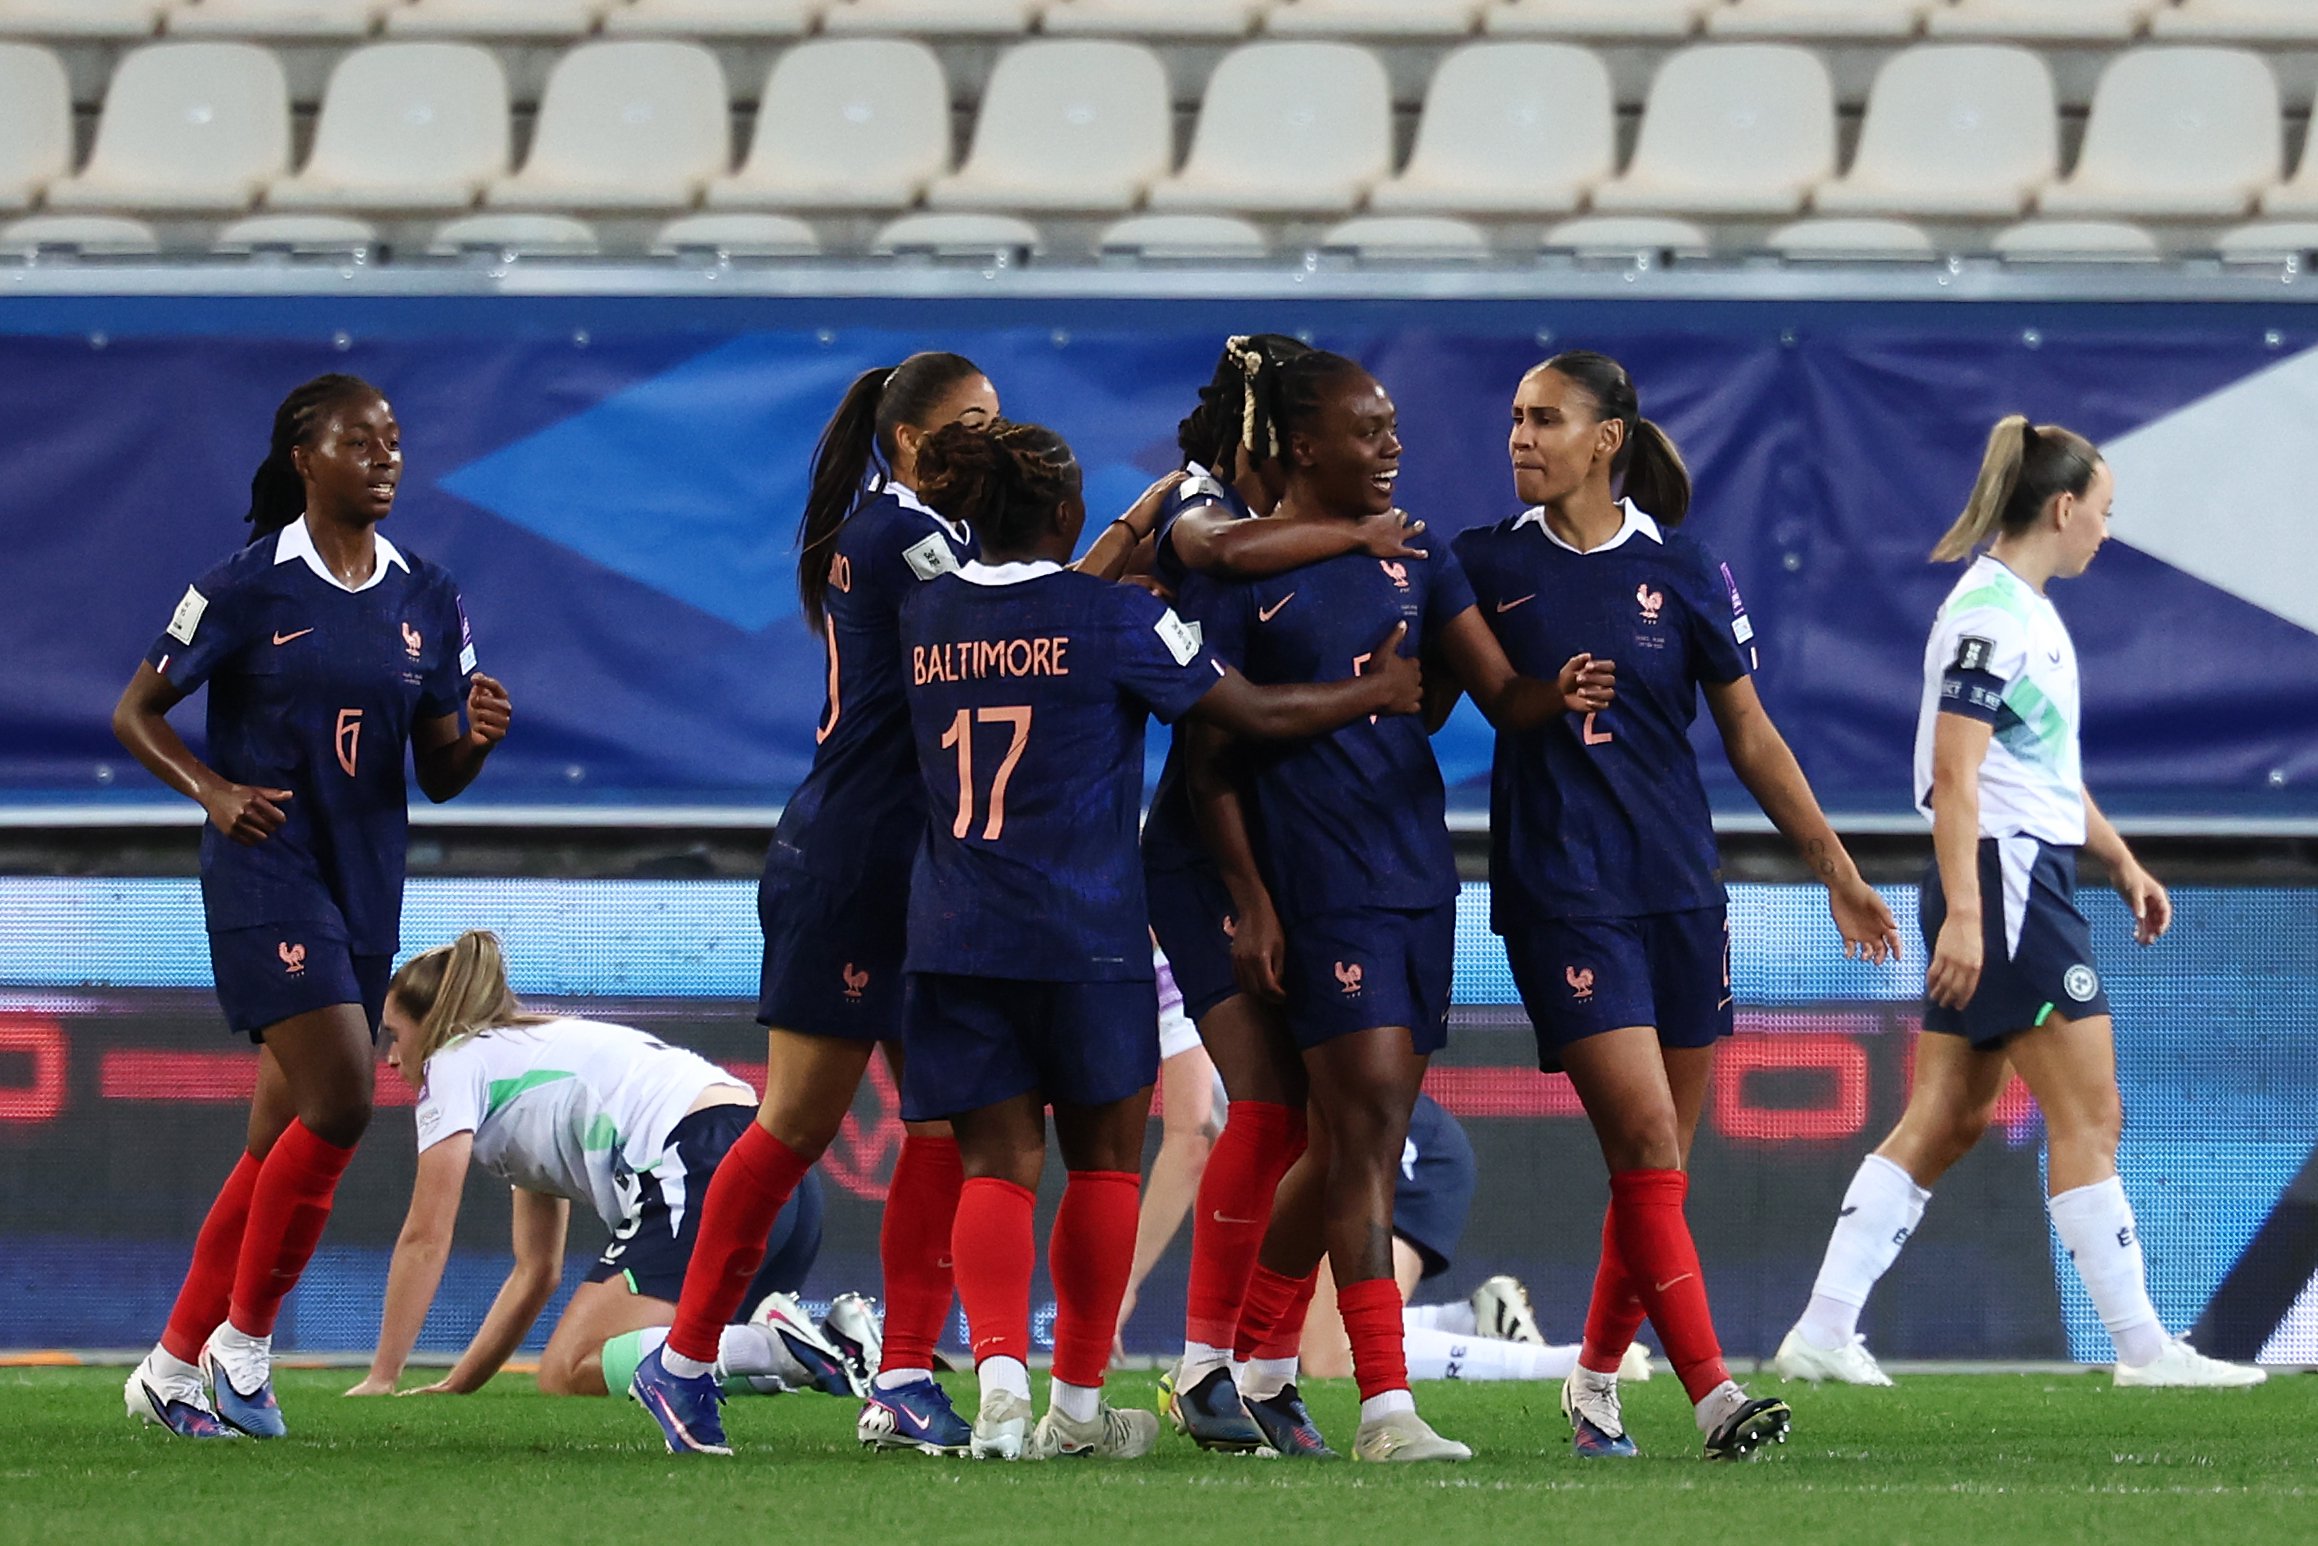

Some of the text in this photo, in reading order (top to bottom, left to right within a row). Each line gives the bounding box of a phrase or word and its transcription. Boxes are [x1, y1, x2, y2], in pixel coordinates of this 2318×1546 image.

[913, 637, 1069, 686] BALTIMORE
[335, 708, 363, 777] 6
[941, 705, 1032, 840] 17
